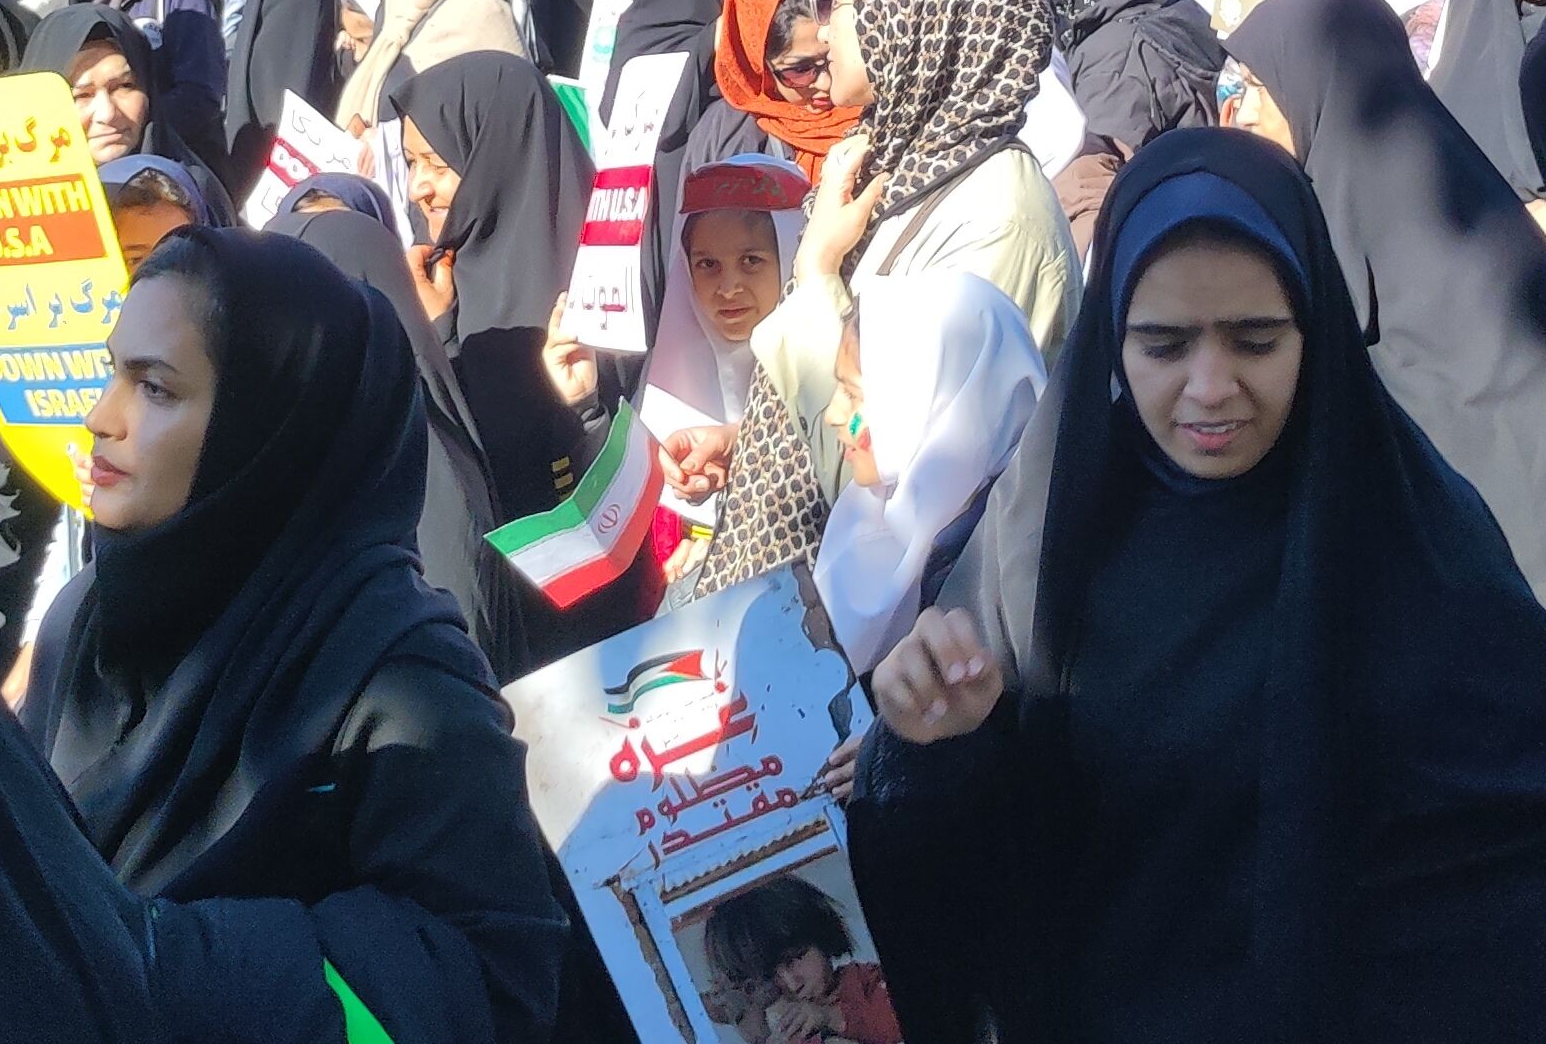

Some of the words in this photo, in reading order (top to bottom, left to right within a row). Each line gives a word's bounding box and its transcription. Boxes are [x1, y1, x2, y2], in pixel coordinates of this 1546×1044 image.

[16, 116, 71, 162] مرگ
[14, 180, 92, 217] WITH
[47, 291, 65, 329] بر
[62, 347, 113, 380] WI
[24, 387, 104, 418] ISRAE
[647, 786, 799, 871] مقتدر
